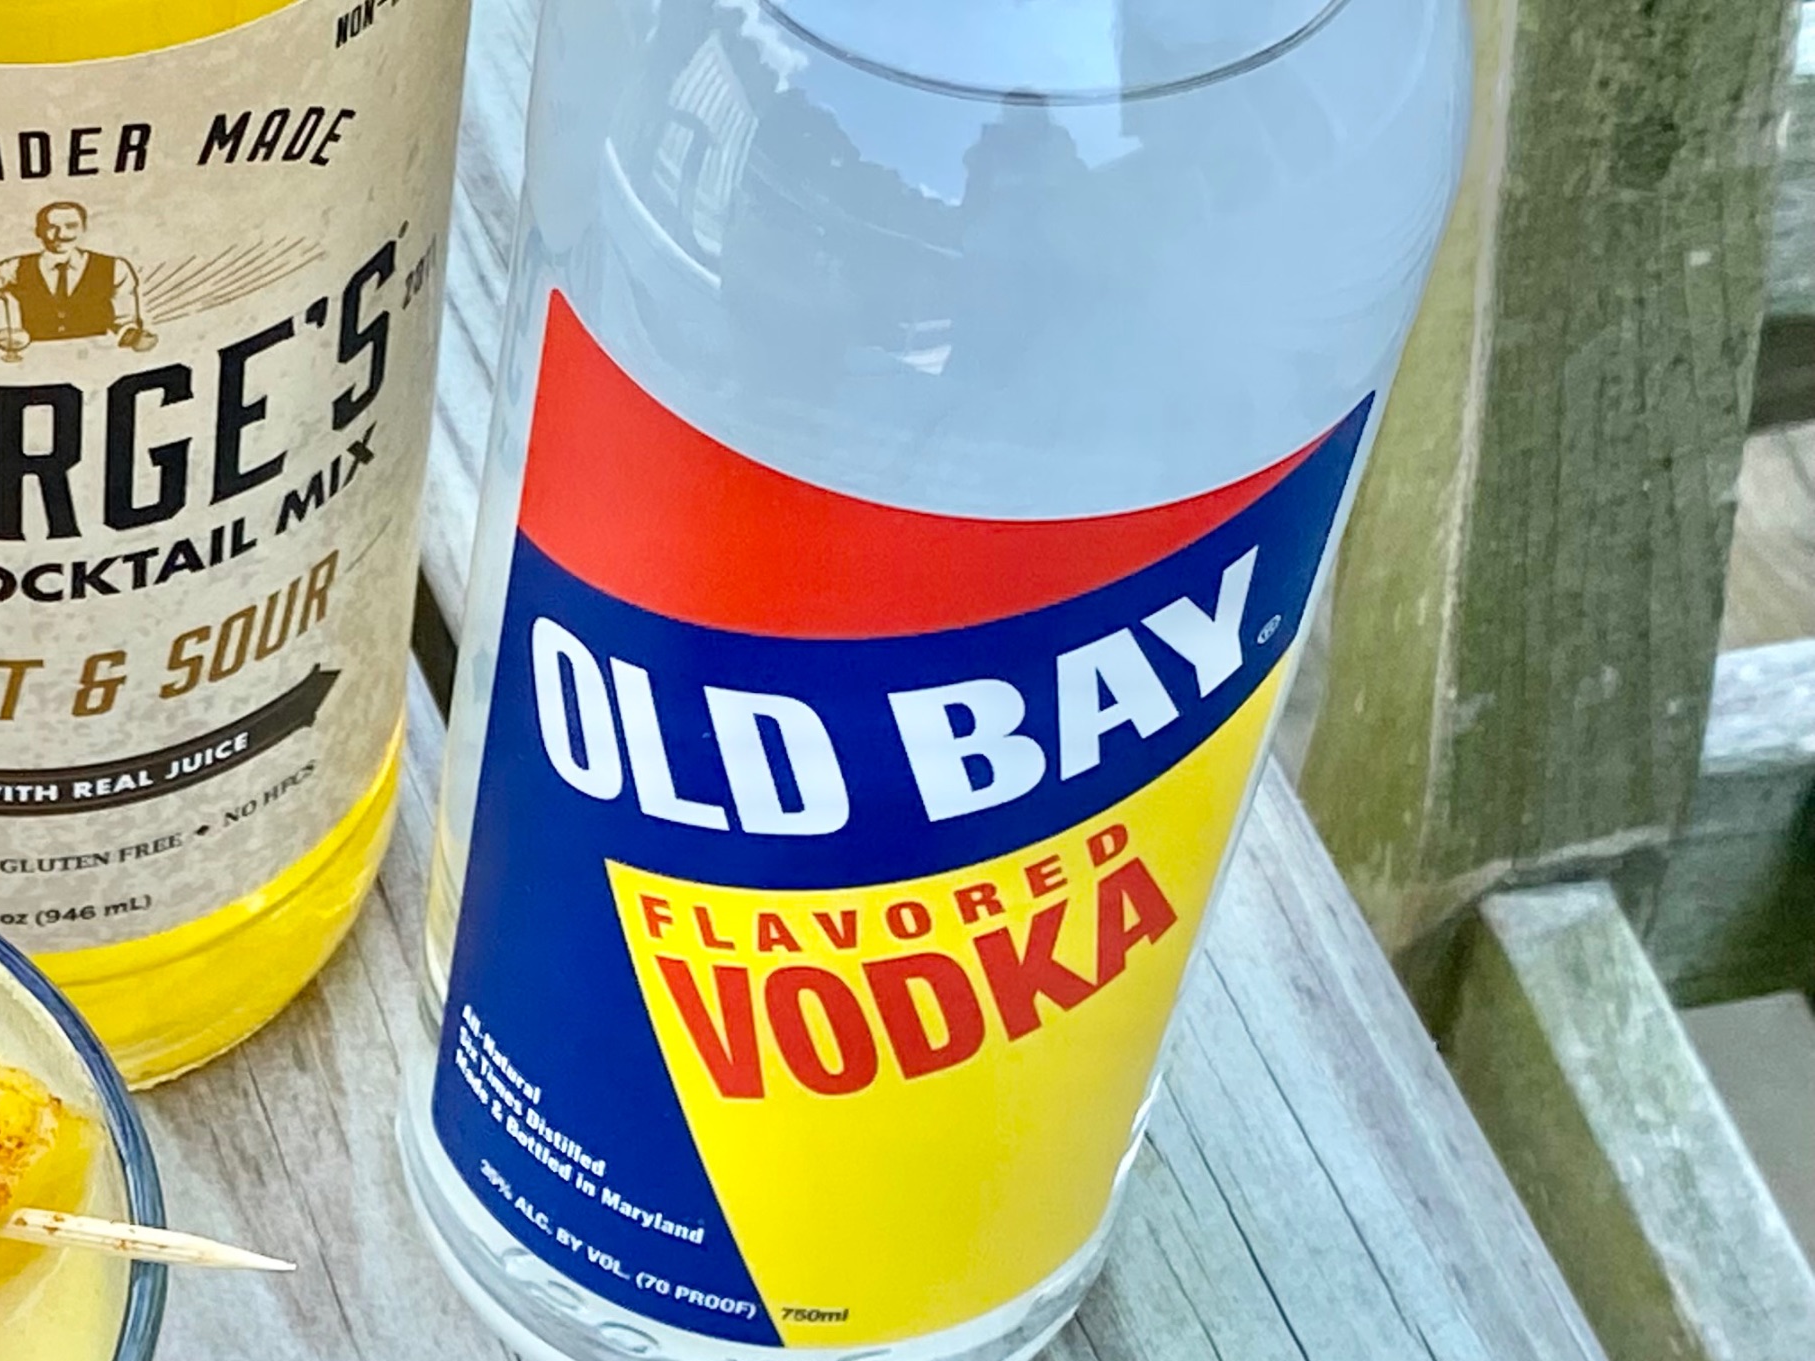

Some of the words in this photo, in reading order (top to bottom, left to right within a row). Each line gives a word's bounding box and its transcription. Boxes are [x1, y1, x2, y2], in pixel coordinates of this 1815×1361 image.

[335, 0, 399, 49] NON-
[197, 107, 356, 167] MADE
[274, 420, 378, 538] MIX
[71, 650, 127, 719] &
[158, 548, 340, 701] SOUR
[530, 616, 850, 836] OLD
[886, 544, 1260, 823] BAY
[72, 769, 155, 800] REAL
[164, 730, 251, 782] JUICE
[118, 832, 184, 864] FREE
[222, 799, 258, 829] NO
[640, 824, 1129, 953] FLAVORED
[0, 913, 30, 926] oz
[35, 905, 97, 928] (946
[103, 894, 153, 918] mL)
[658, 857, 1179, 1101] VODKA
[461, 1003, 542, 1106] All-Natural
[455, 1047, 488, 1106] Made
[491, 1099, 504, 1123] &
[506, 1114, 574, 1183] Bottled
[576, 1171, 597, 1198] in
[600, 1186, 706, 1246] Maryland
[479, 1054, 523, 1117] Times
[525, 1106, 607, 1178] Distilled
[514, 1196, 554, 1237] ALC.
[556, 1227, 584, 1254] BY
[587, 1244, 631, 1281] VOL.
[635, 1271, 670, 1296] (70
[674, 1285, 759, 1320] PROOF)
[780, 1307, 850, 1324] 750ml
